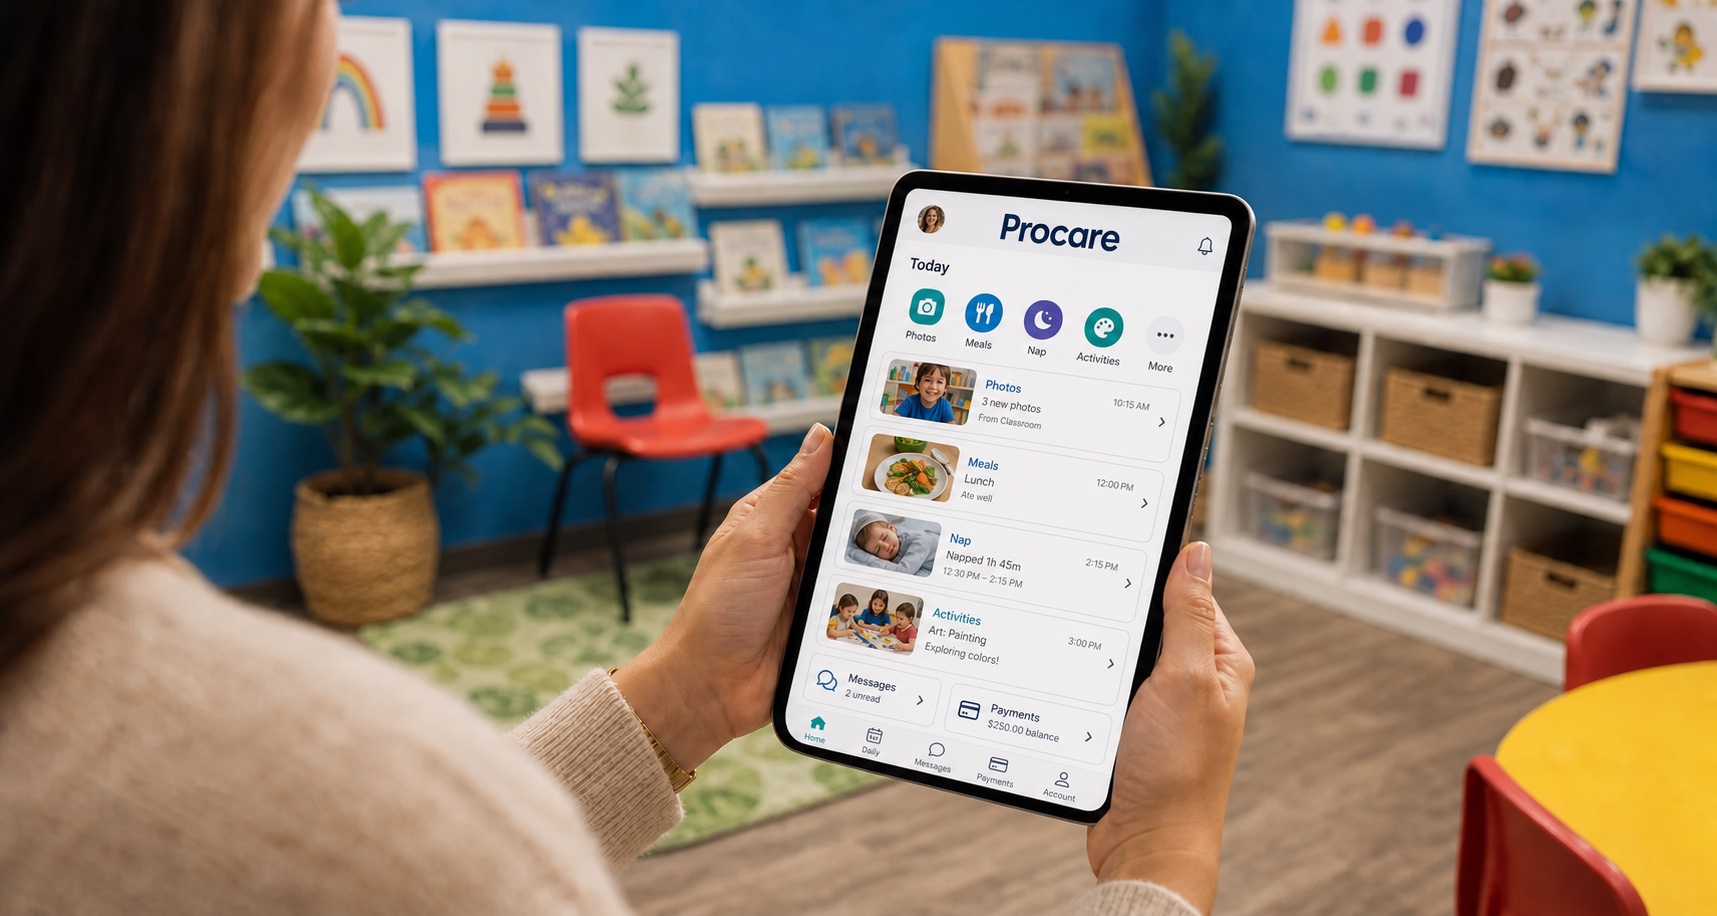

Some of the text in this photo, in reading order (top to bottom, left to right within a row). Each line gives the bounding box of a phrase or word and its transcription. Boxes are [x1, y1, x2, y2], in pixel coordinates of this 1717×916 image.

[1000, 213, 1120, 252] Procare
[911, 257, 950, 276] Today
[905, 330, 936, 342] Photos
[965, 338, 992, 350] Meals
[1027, 345, 1047, 358] Nap
[1076, 352, 1120, 366] Activities
[1148, 361, 1173, 373] More
[985, 379, 1021, 393] Photos
[982, 397, 1041, 414] 3 new photos
[1114, 398, 1150, 411] 10:15 AM
[978, 413, 1042, 430] From Classroom
[968, 457, 999, 471] Meals
[964, 474, 994, 487] Lunch
[1097, 479, 1134, 492] 12:00 PM
[960, 491, 993, 502] Ate well
[950, 533, 971, 547] Nap
[946, 550, 1021, 571] Napped 1h 45m
[1085, 558, 1119, 571] 2:15 PM
[966, 571, 980, 580] PM
[989, 575, 1007, 586] 2:15
[1009, 578, 1023, 588] PM
[932, 608, 981, 626] Activities
[928, 625, 987, 647] Art: Painting
[1068, 637, 1102, 651] 3:00 PM
[925, 642, 999, 665] Exploring colors!
[848, 673, 897, 693] Messages
[845, 689, 881, 703] 2 unread
[991, 704, 1041, 723] Payments
[987, 719, 1060, 743] $250.00 balance
[804, 733, 826, 744] Home
[861, 745, 881, 757] Daily
[914, 758, 952, 774] Messages
[976, 773, 1014, 788] Payments
[1043, 789, 1076, 803] Account
